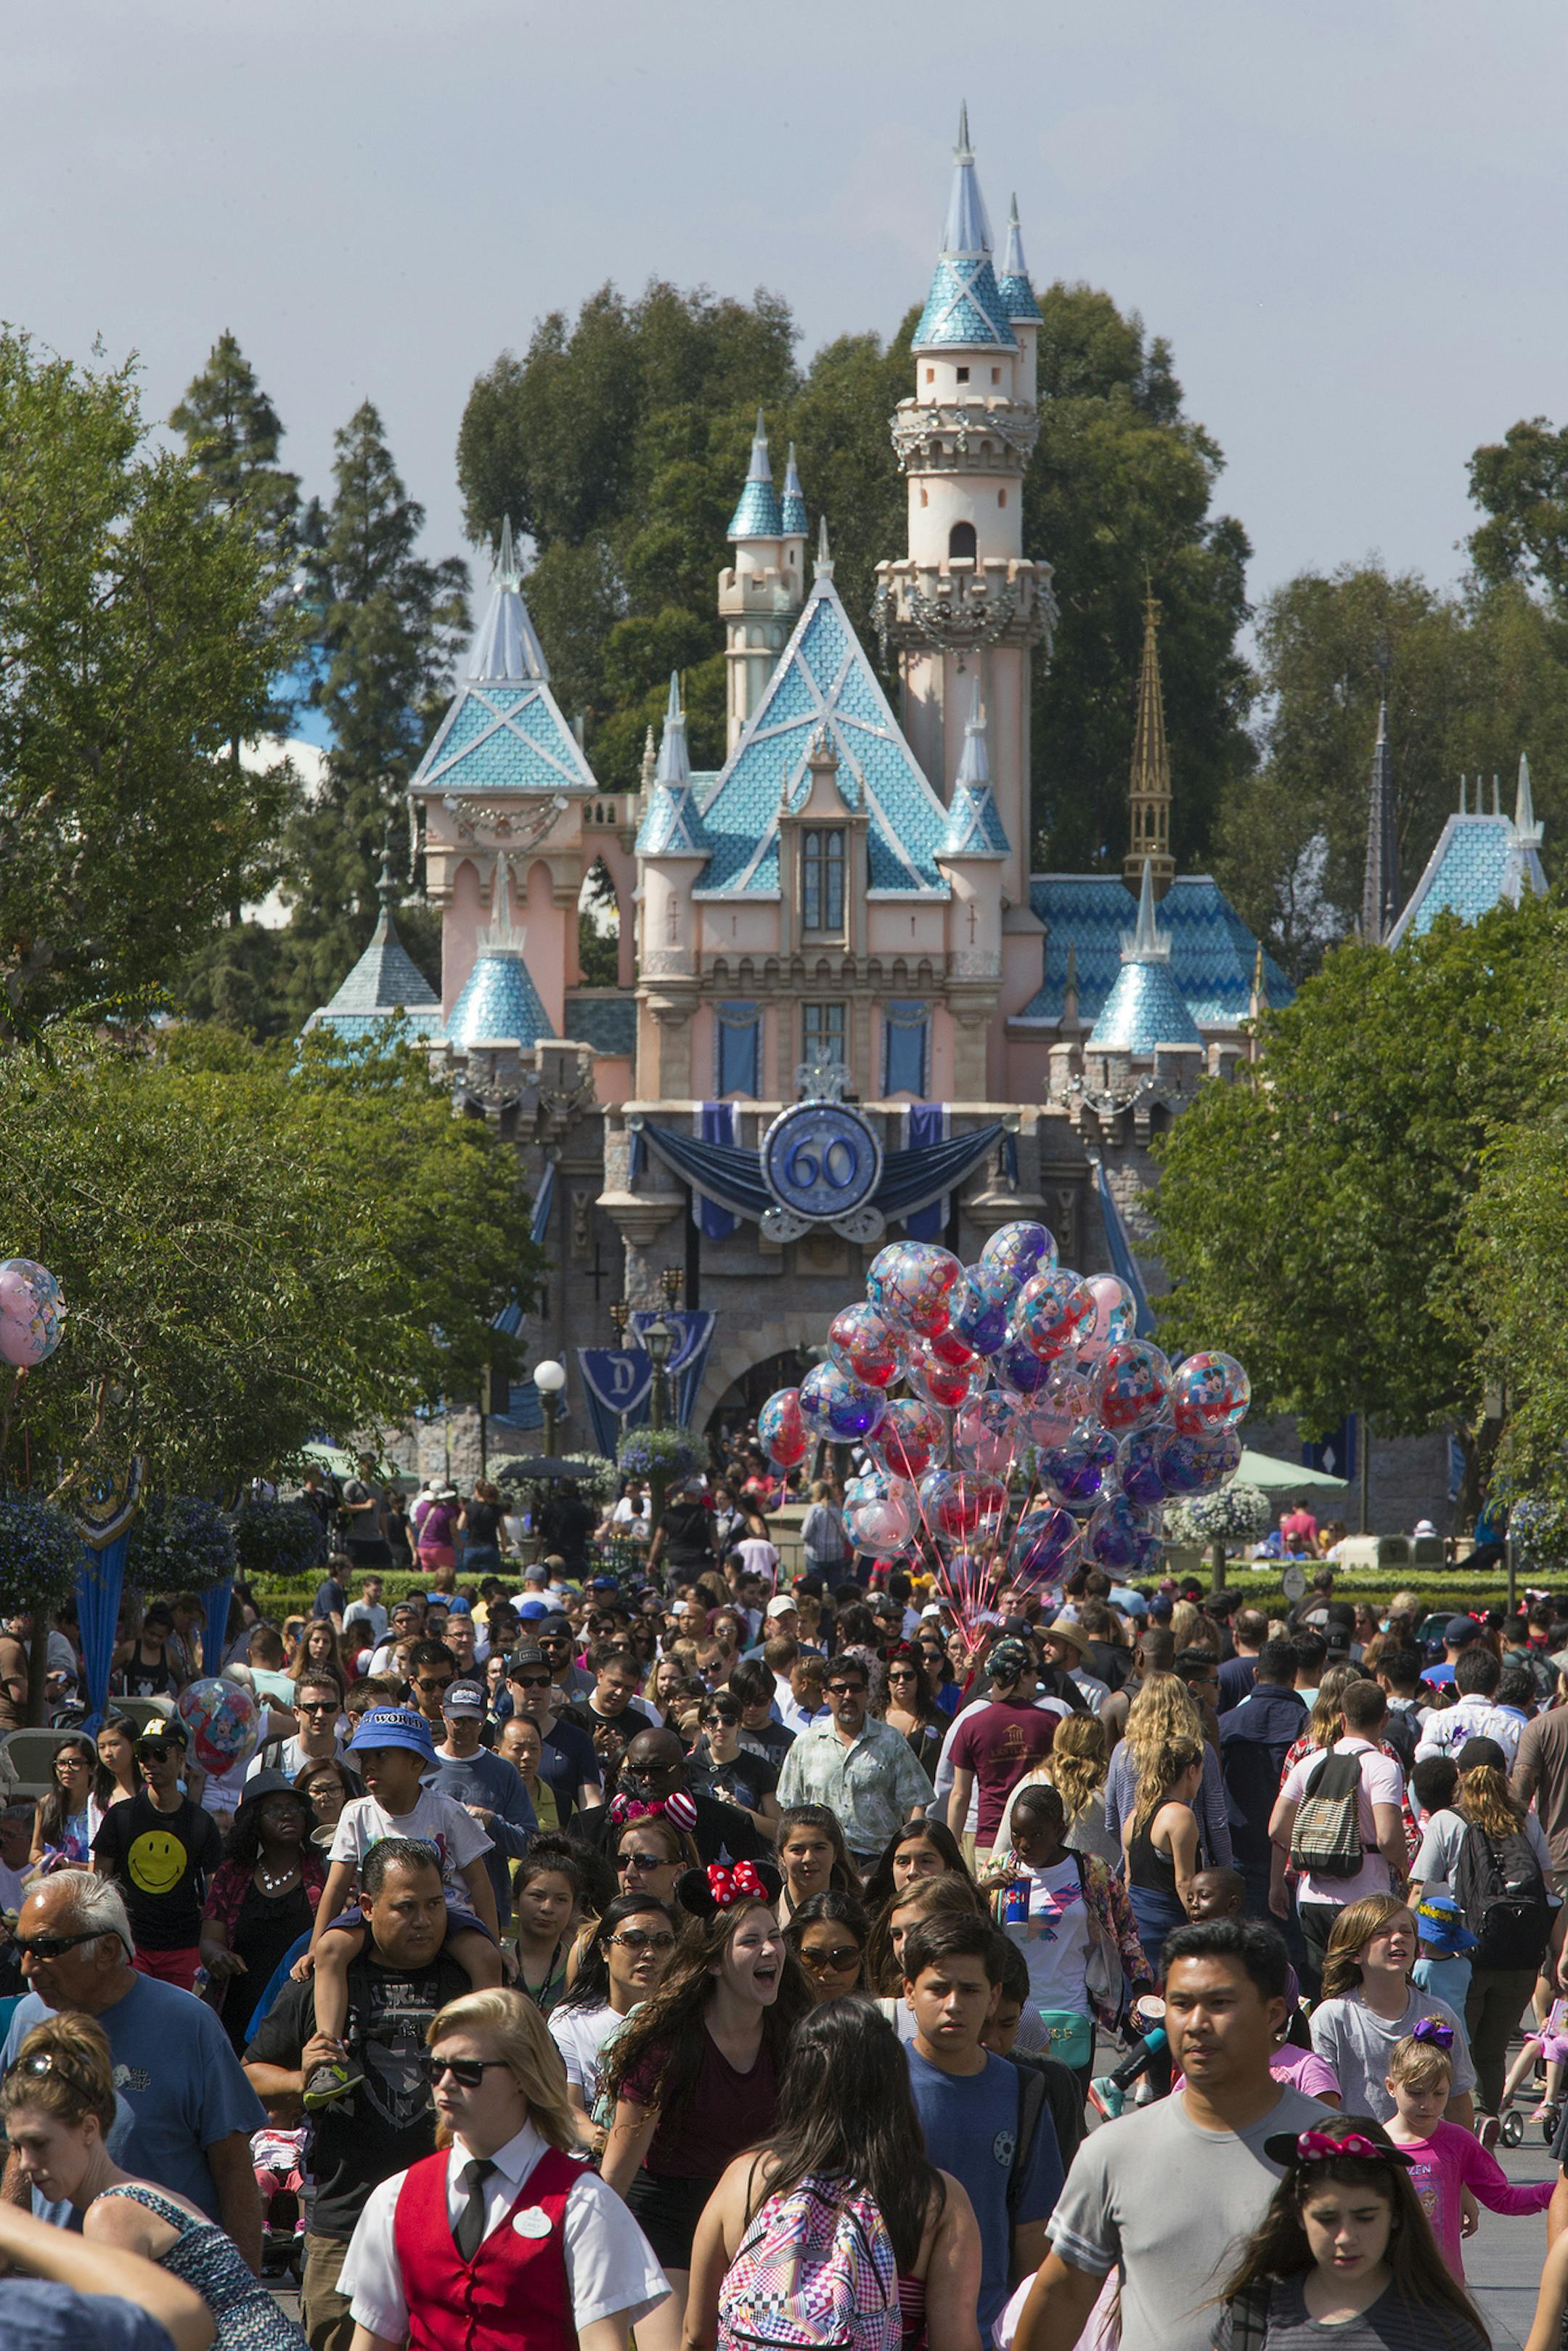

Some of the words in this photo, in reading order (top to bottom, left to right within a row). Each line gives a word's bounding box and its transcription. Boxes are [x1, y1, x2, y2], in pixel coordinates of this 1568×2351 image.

[785, 1134, 857, 1189] 60
[607, 1355, 635, 1395] D
[142, 1718, 168, 1737] H
[375, 1713, 423, 1730] WORLD
[131, 2068, 149, 2077] OLD
